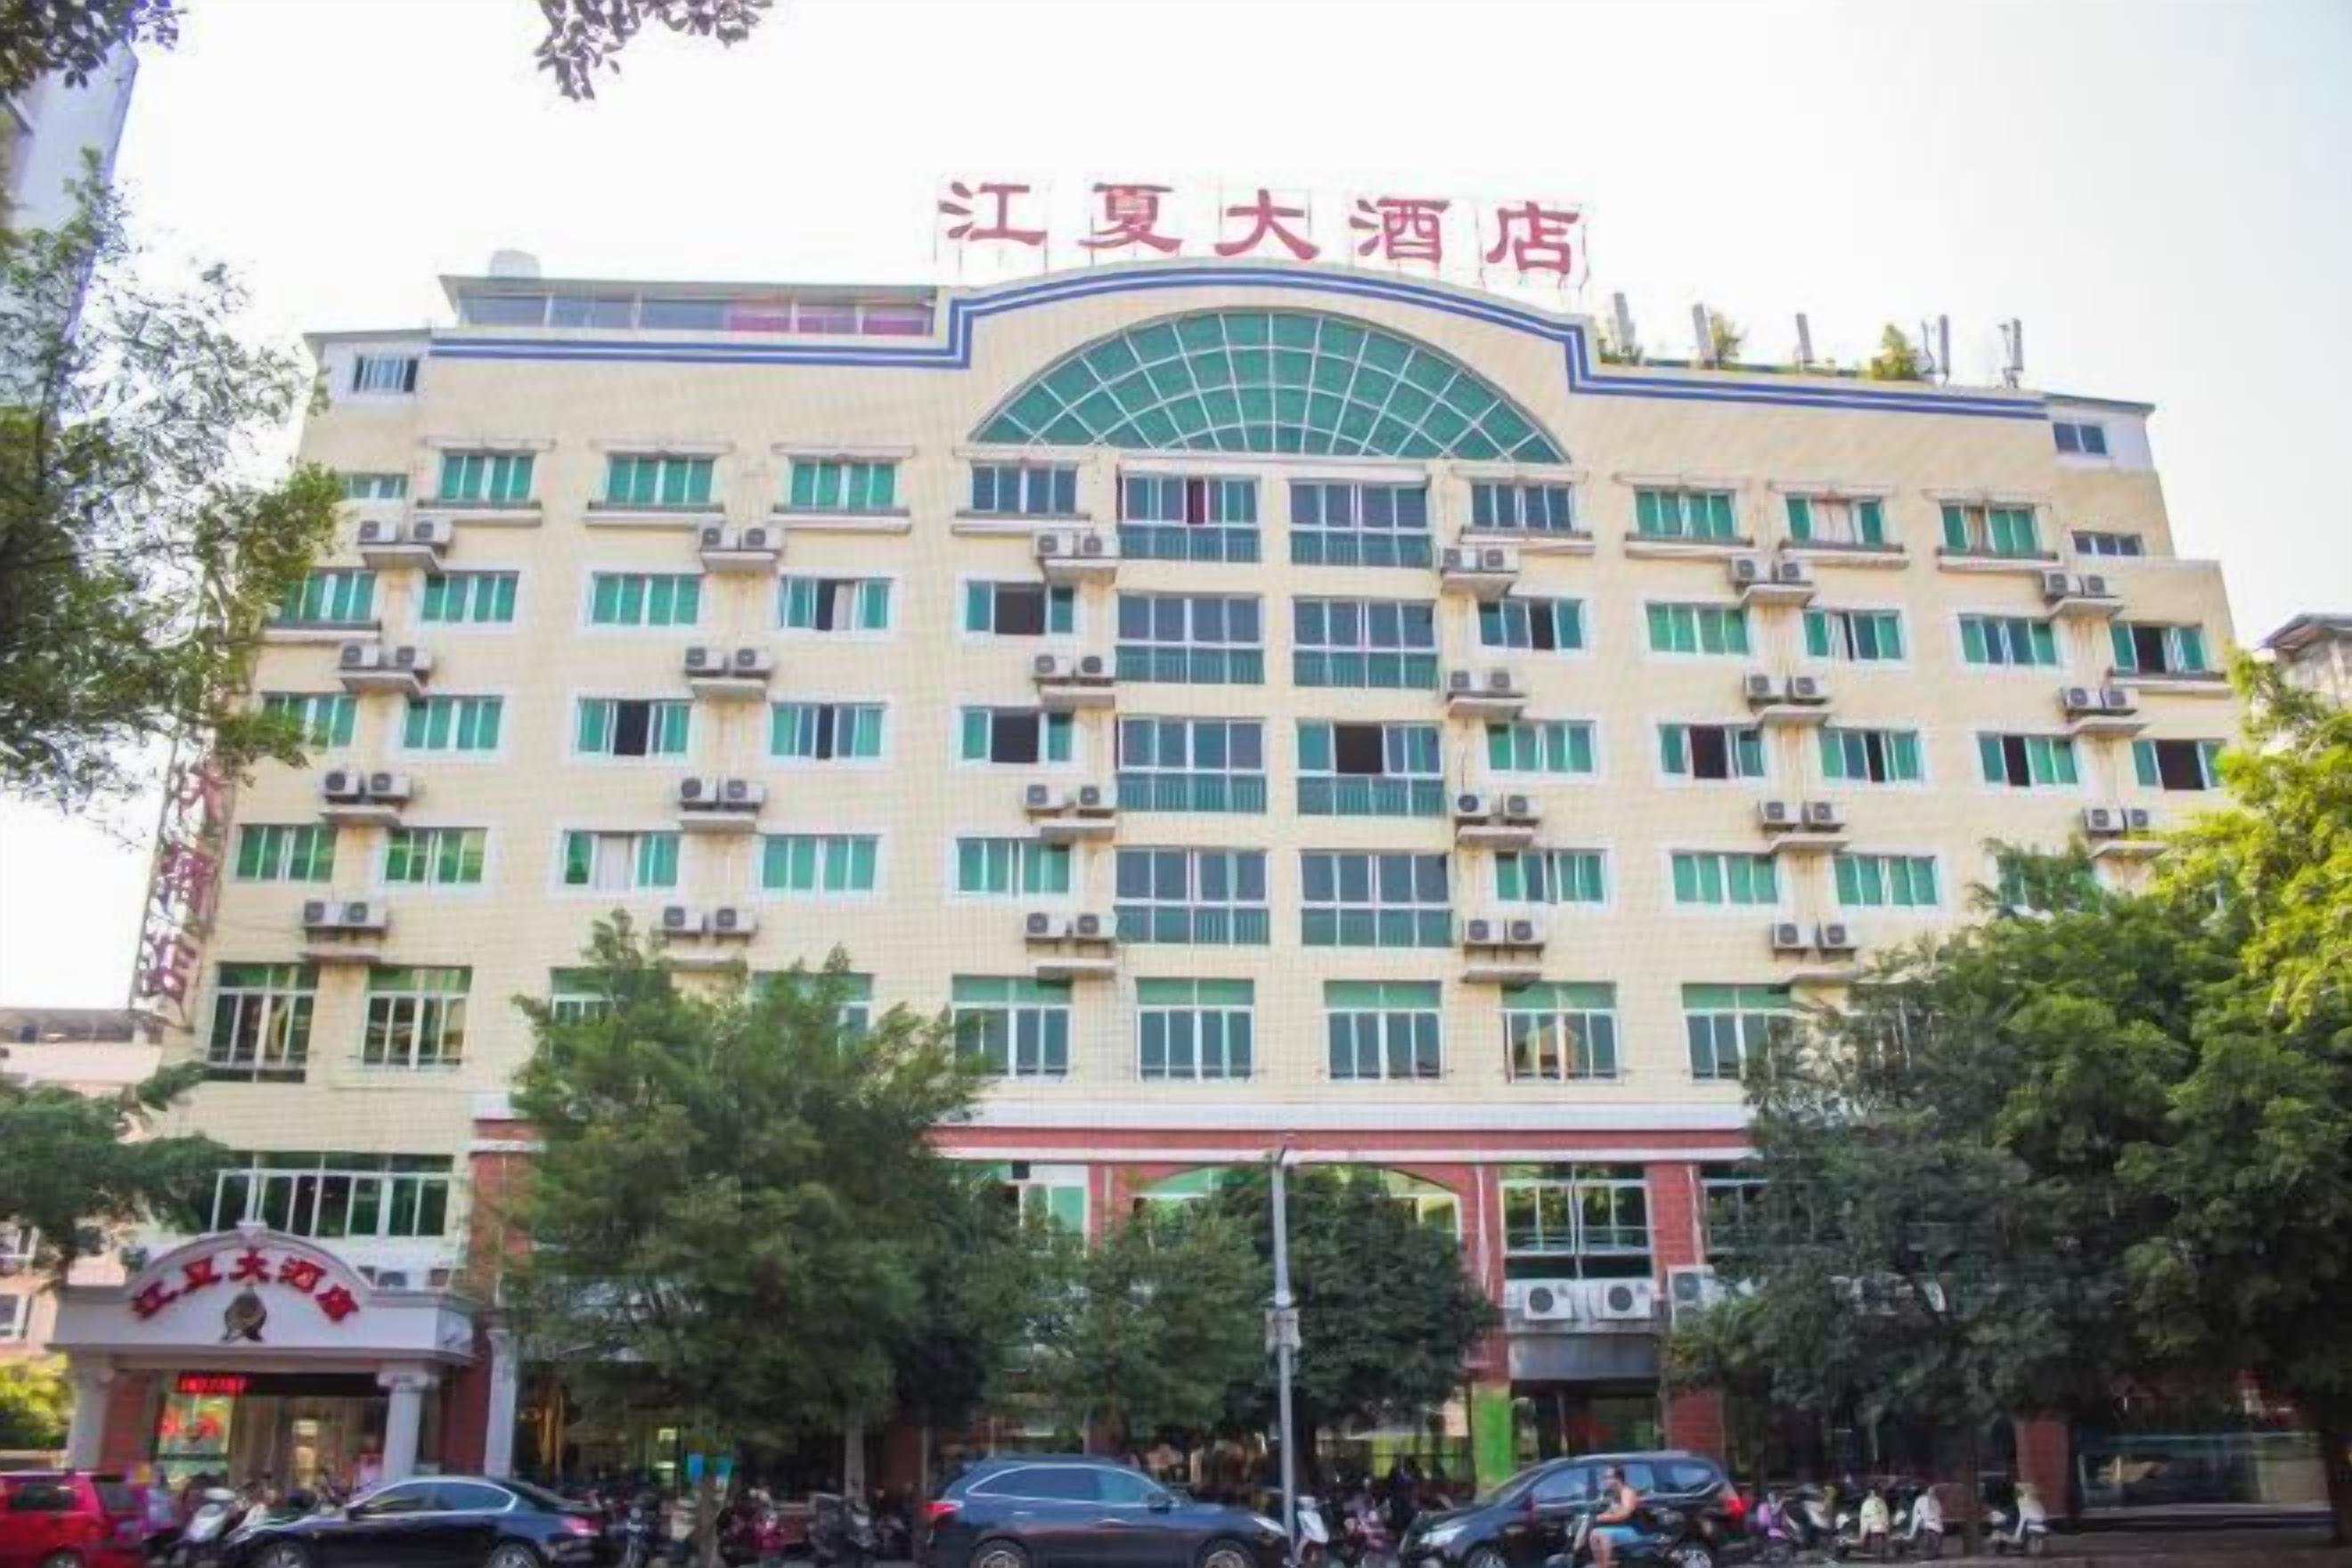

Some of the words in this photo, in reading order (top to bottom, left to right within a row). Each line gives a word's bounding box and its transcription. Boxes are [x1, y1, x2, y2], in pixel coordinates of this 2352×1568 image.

[939, 182, 1579, 274] 江夏大酒店
